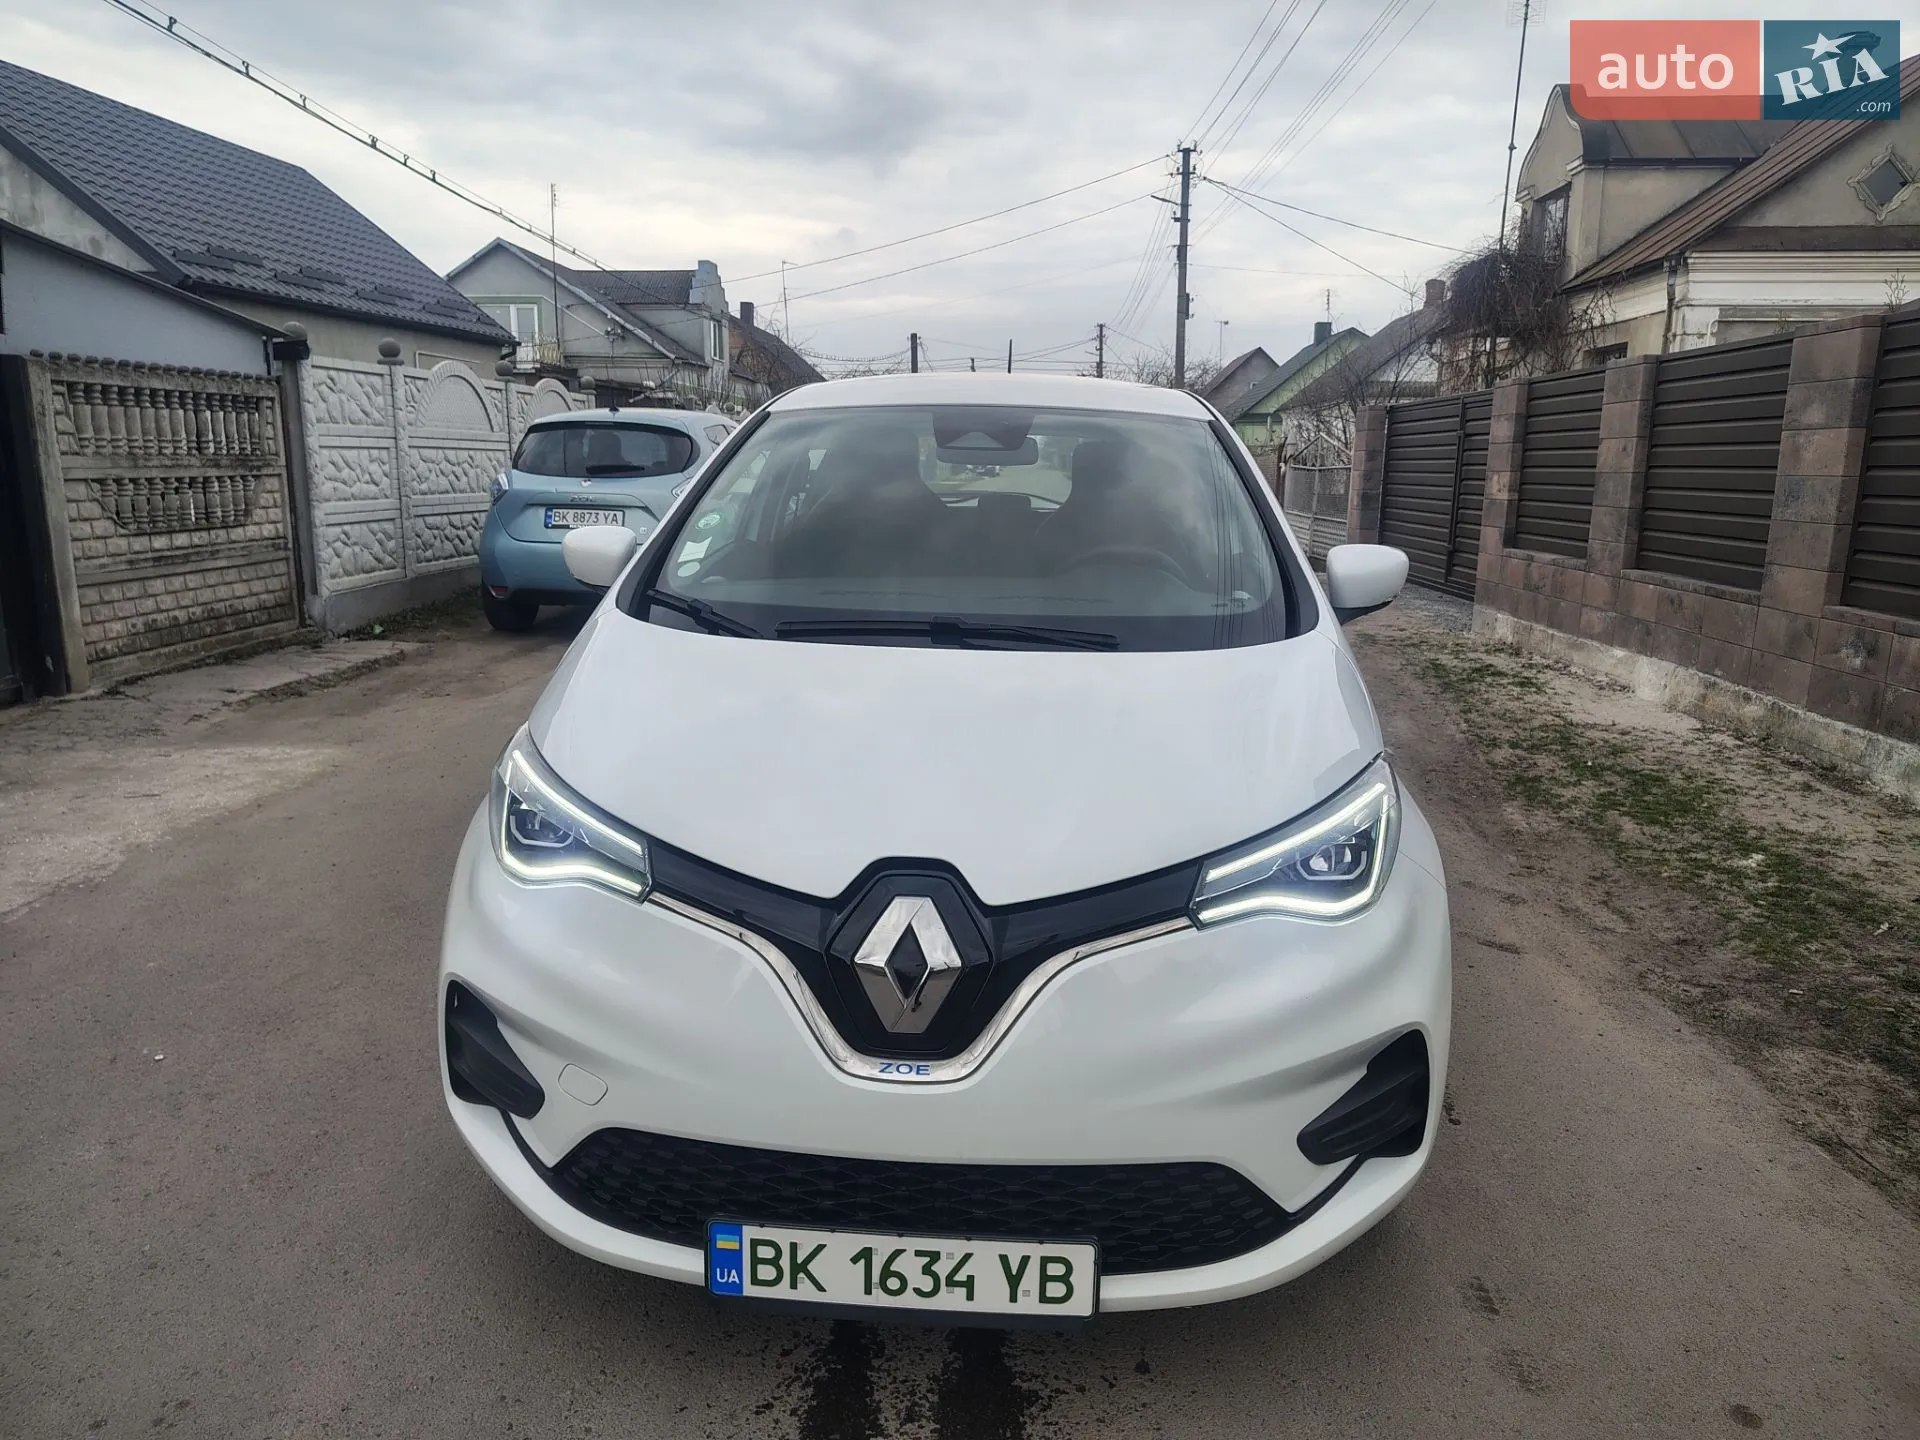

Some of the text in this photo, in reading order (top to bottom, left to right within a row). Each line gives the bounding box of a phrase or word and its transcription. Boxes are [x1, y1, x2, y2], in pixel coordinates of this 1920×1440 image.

[553, 511, 569, 522] BK
[573, 512, 599, 523] 8873
[603, 512, 618, 524] YA
[879, 1062, 930, 1076] ZOE
[716, 1267, 740, 1285] UA
[749, 1238, 1075, 1305] BK 1634 YB
